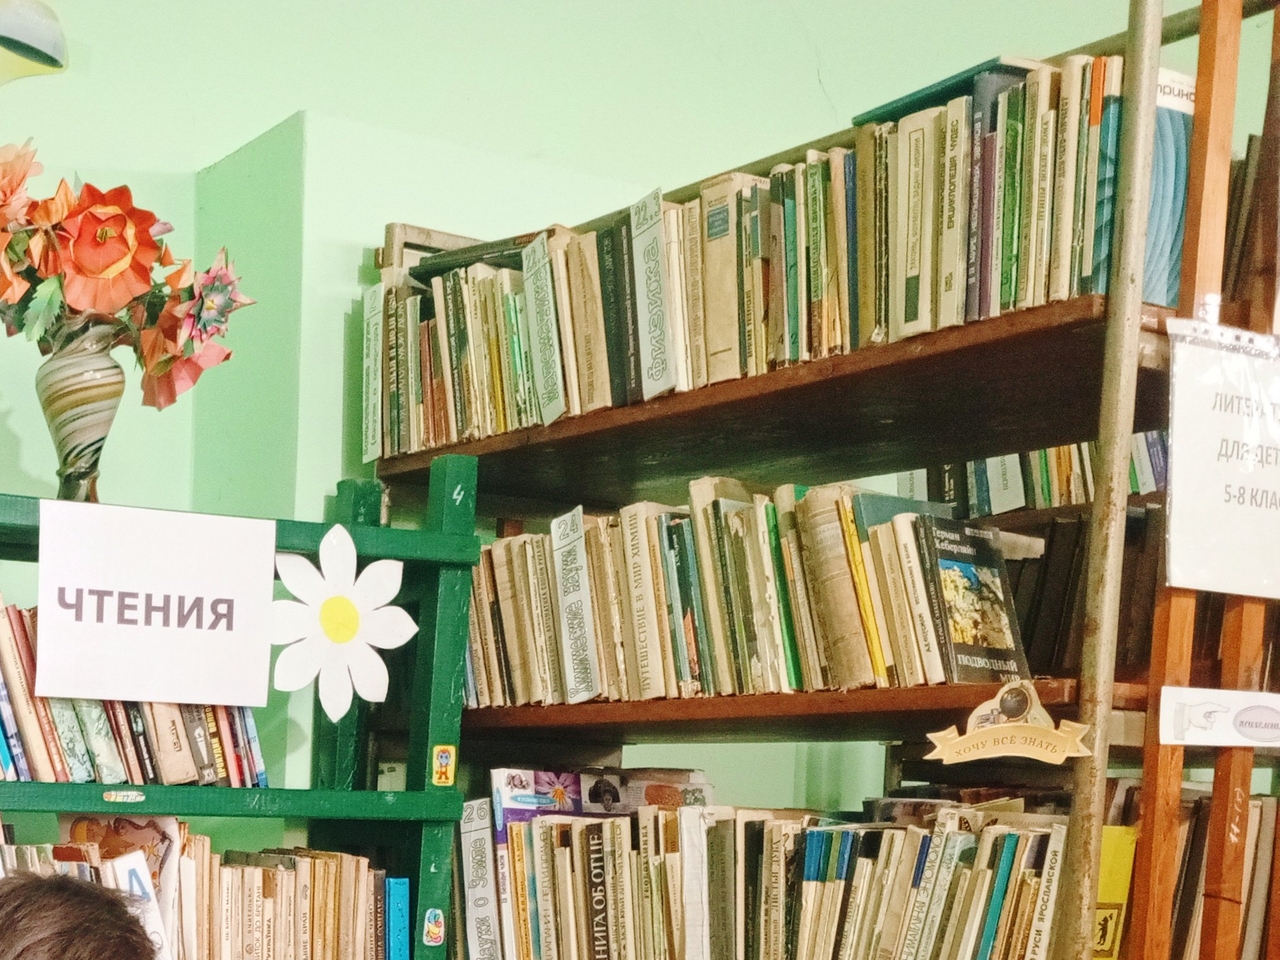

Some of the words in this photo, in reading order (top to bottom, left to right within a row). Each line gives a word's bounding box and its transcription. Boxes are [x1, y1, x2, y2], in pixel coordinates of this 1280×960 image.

[949, 119, 959, 150] ЧУДЕС
[973, 122, 981, 159] ЗВУКОВ
[634, 192, 661, 231] 22.3
[945, 155, 958, 229] ЕНЦИКЛОПЕДІЯ
[639, 237, 667, 381] Физика
[526, 265, 561, 408] Математика
[452, 484, 464, 505] 4
[1224, 484, 1245, 505] 5-8
[627, 512, 641, 556] ХИМИИ
[932, 526, 961, 542] Герман
[558, 544, 585, 596] науки
[631, 561, 642, 588] МИР
[56, 586, 235, 632] ЧТЕНИЯ
[559, 599, 594, 697] Химические
[634, 605, 652, 690] ПУТЕШЕСТВИЕ
[956, 654, 1019, 673] ПОДВОДНЫЙ
[16, 670, 32, 714] КОНСТАНТИН
[210, 736, 227, 777] ПРОКУДИН
[954, 738, 988, 758] ХОЧУ
[992, 734, 1018, 748] ВСЁ
[1020, 735, 1059, 755] ЗНАТЬ
[464, 800, 489, 824] 26
[466, 837, 487, 888] Земле
[588, 833, 604, 882] ОТЦЕ
[771, 840, 781, 866] ДУБА
[473, 897, 488, 908] о
[591, 886, 606, 909] ОБ
[770, 871, 780, 912] ЛИСТЬЯ
[1036, 848, 1059, 922] ЯРОСЛАВСКОЙ
[1031, 929, 1043, 955] РУСИ
